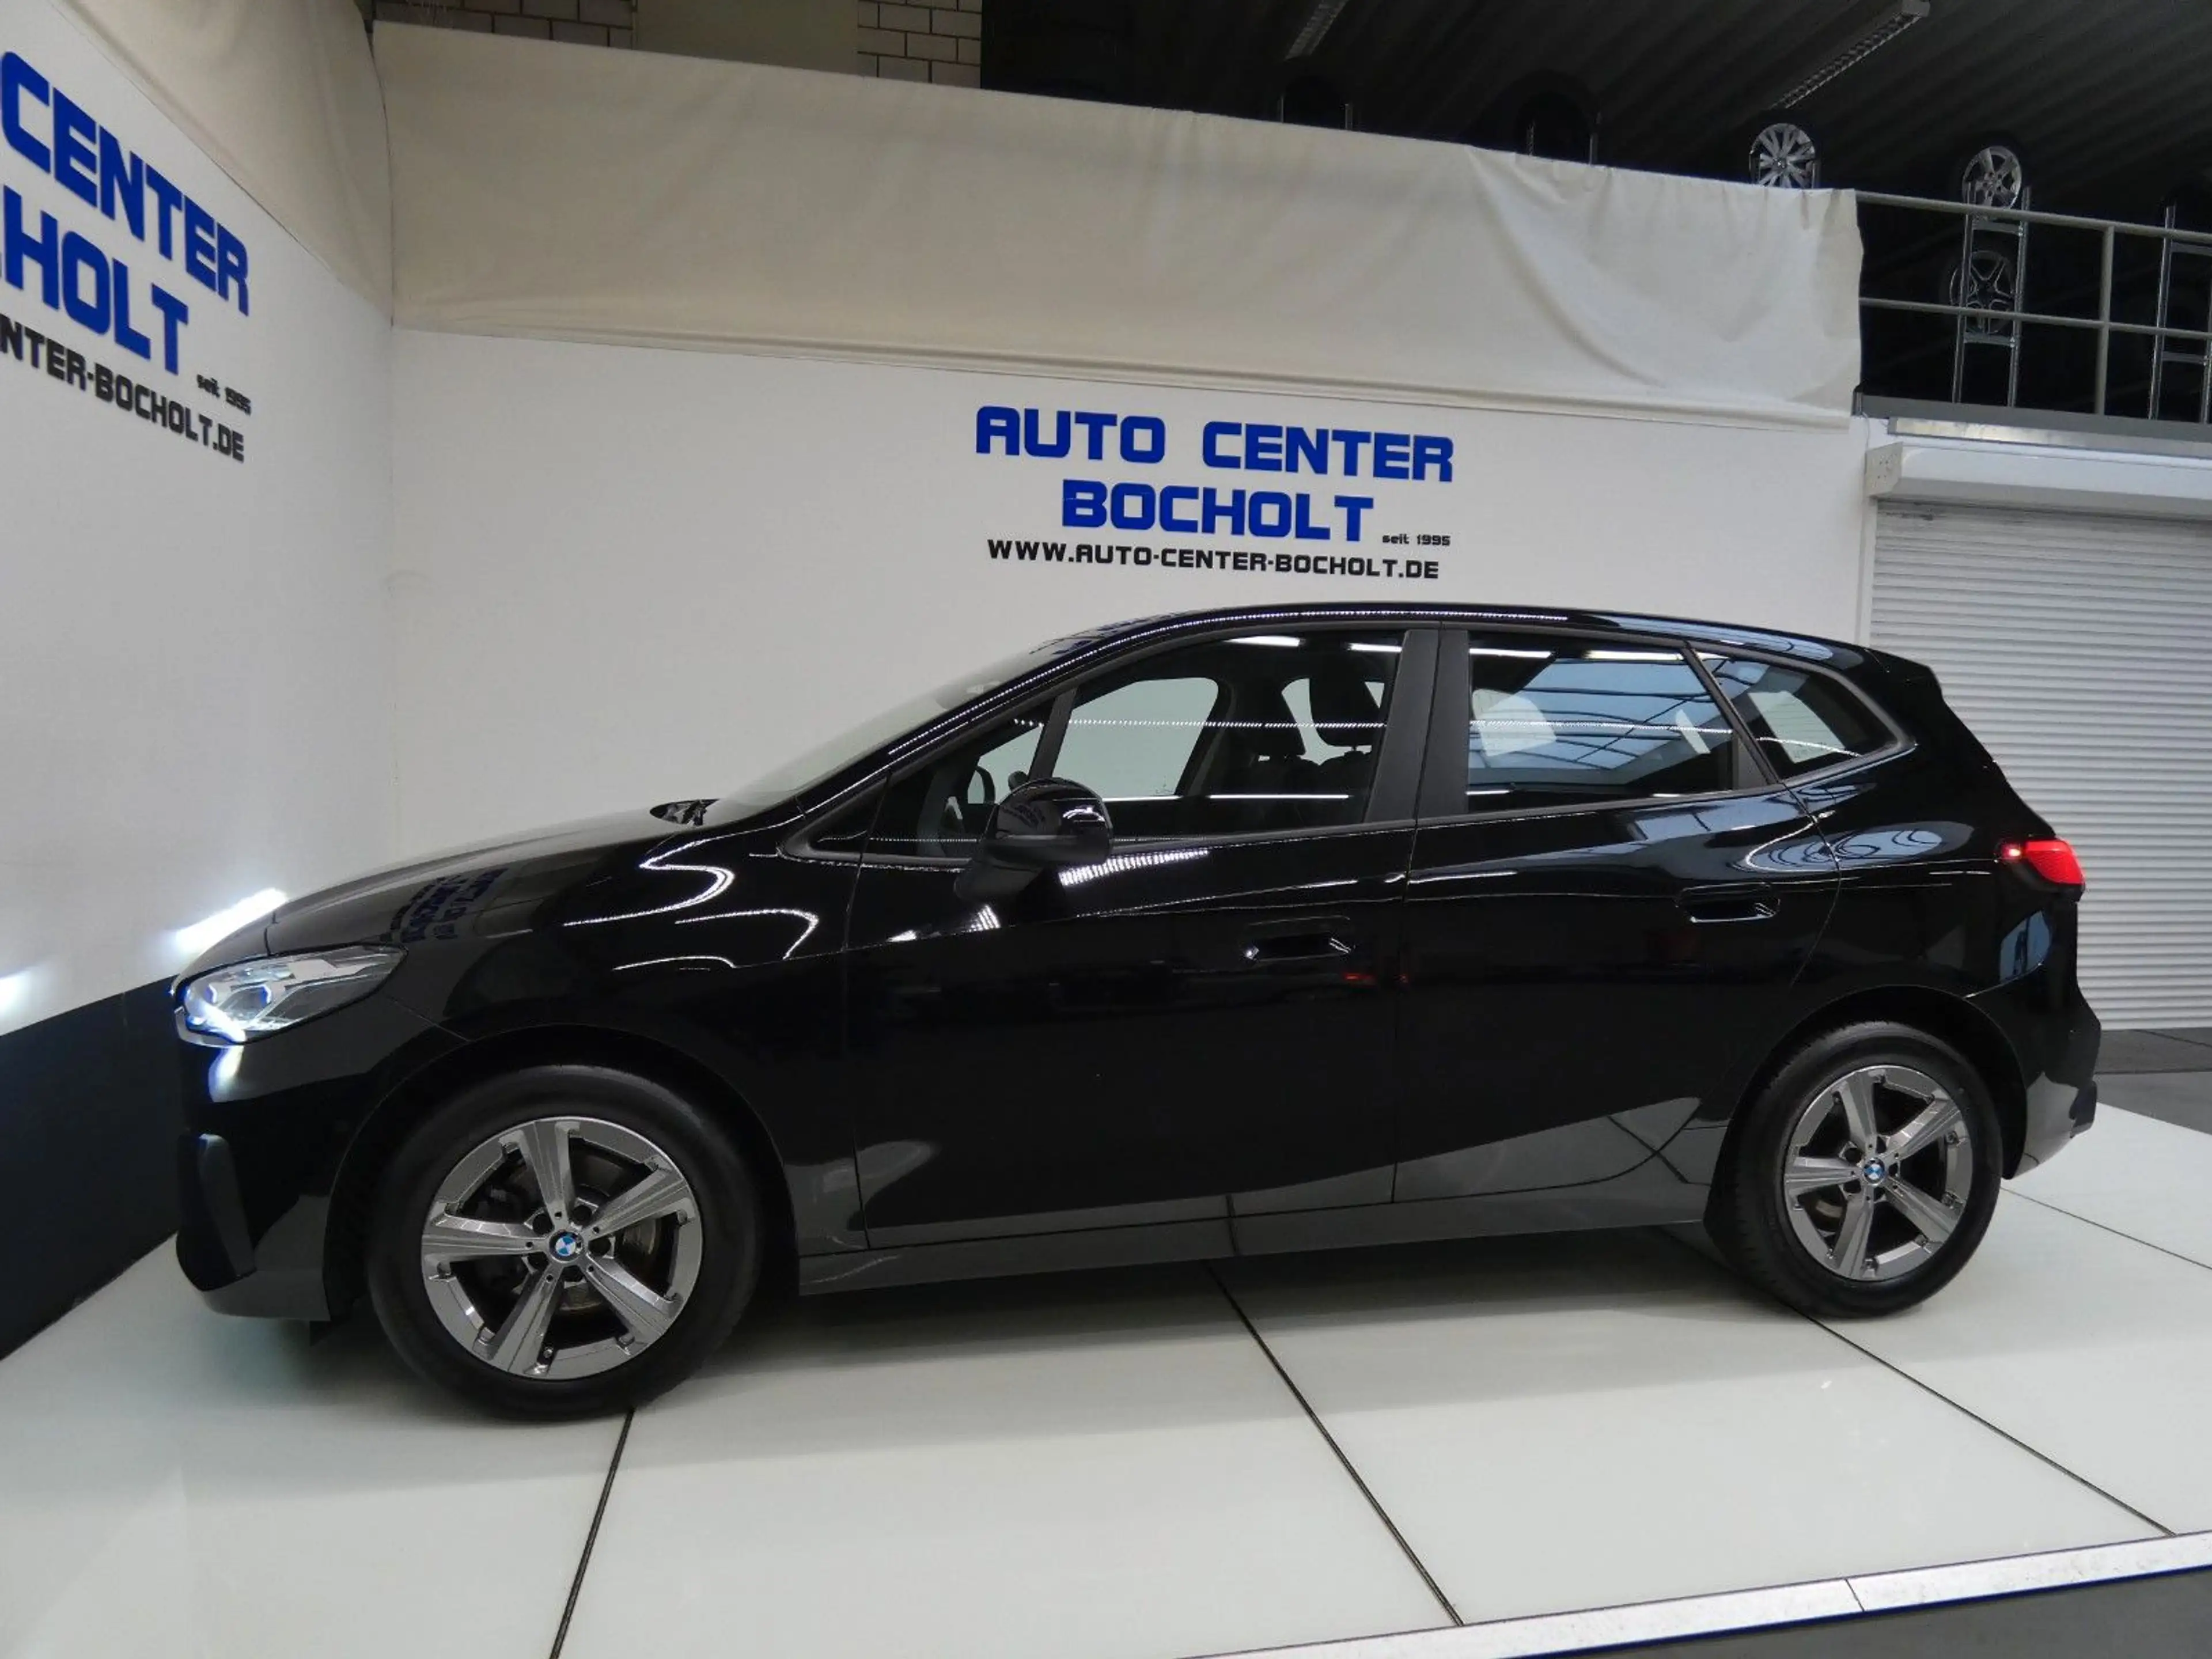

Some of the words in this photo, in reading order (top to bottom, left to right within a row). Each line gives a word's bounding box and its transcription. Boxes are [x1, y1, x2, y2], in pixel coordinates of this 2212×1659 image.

[0, 51, 249, 316] CENTER
[0, 185, 189, 376] HOLT
[976, 406, 1166, 464] AUTO
[1202, 421, 1453, 482] CENTER
[1062, 479, 1374, 543] BOCHOLT
[1382, 534, 1410, 544] seit
[1416, 535, 1450, 546] 1995
[987, 539, 1439, 579] WWW.AUTO-CENTER-BOCHOLT.DE
